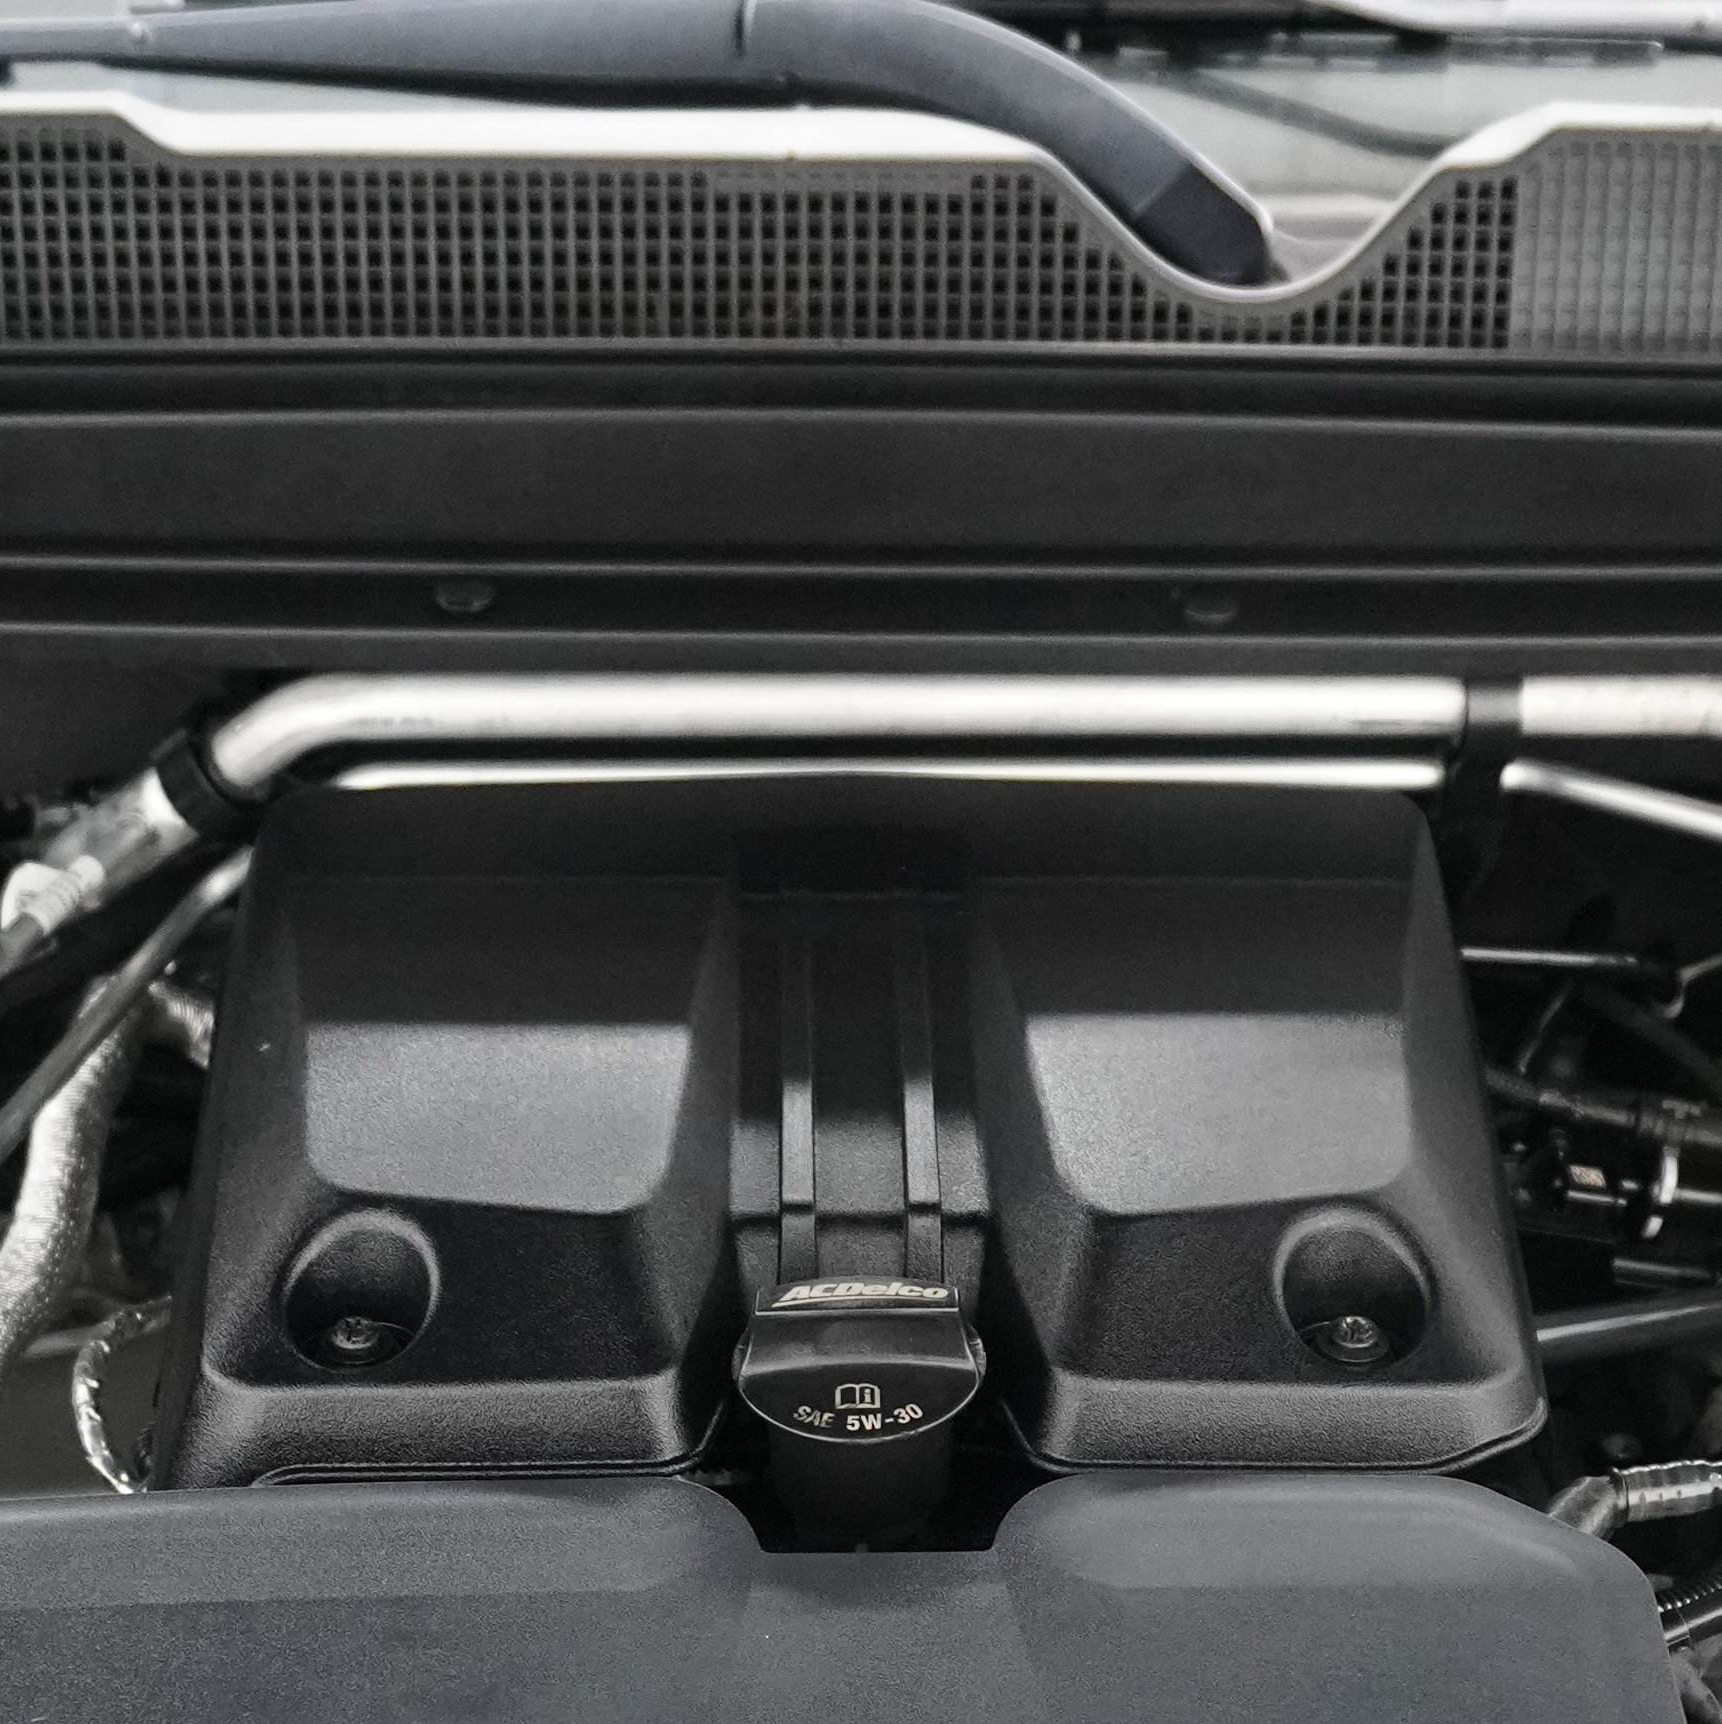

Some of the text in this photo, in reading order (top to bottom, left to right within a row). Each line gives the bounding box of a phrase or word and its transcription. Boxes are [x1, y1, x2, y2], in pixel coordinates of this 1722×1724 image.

[777, 1281, 950, 1303] ACDelco
[792, 1402, 924, 1432] SAE 5W-30
